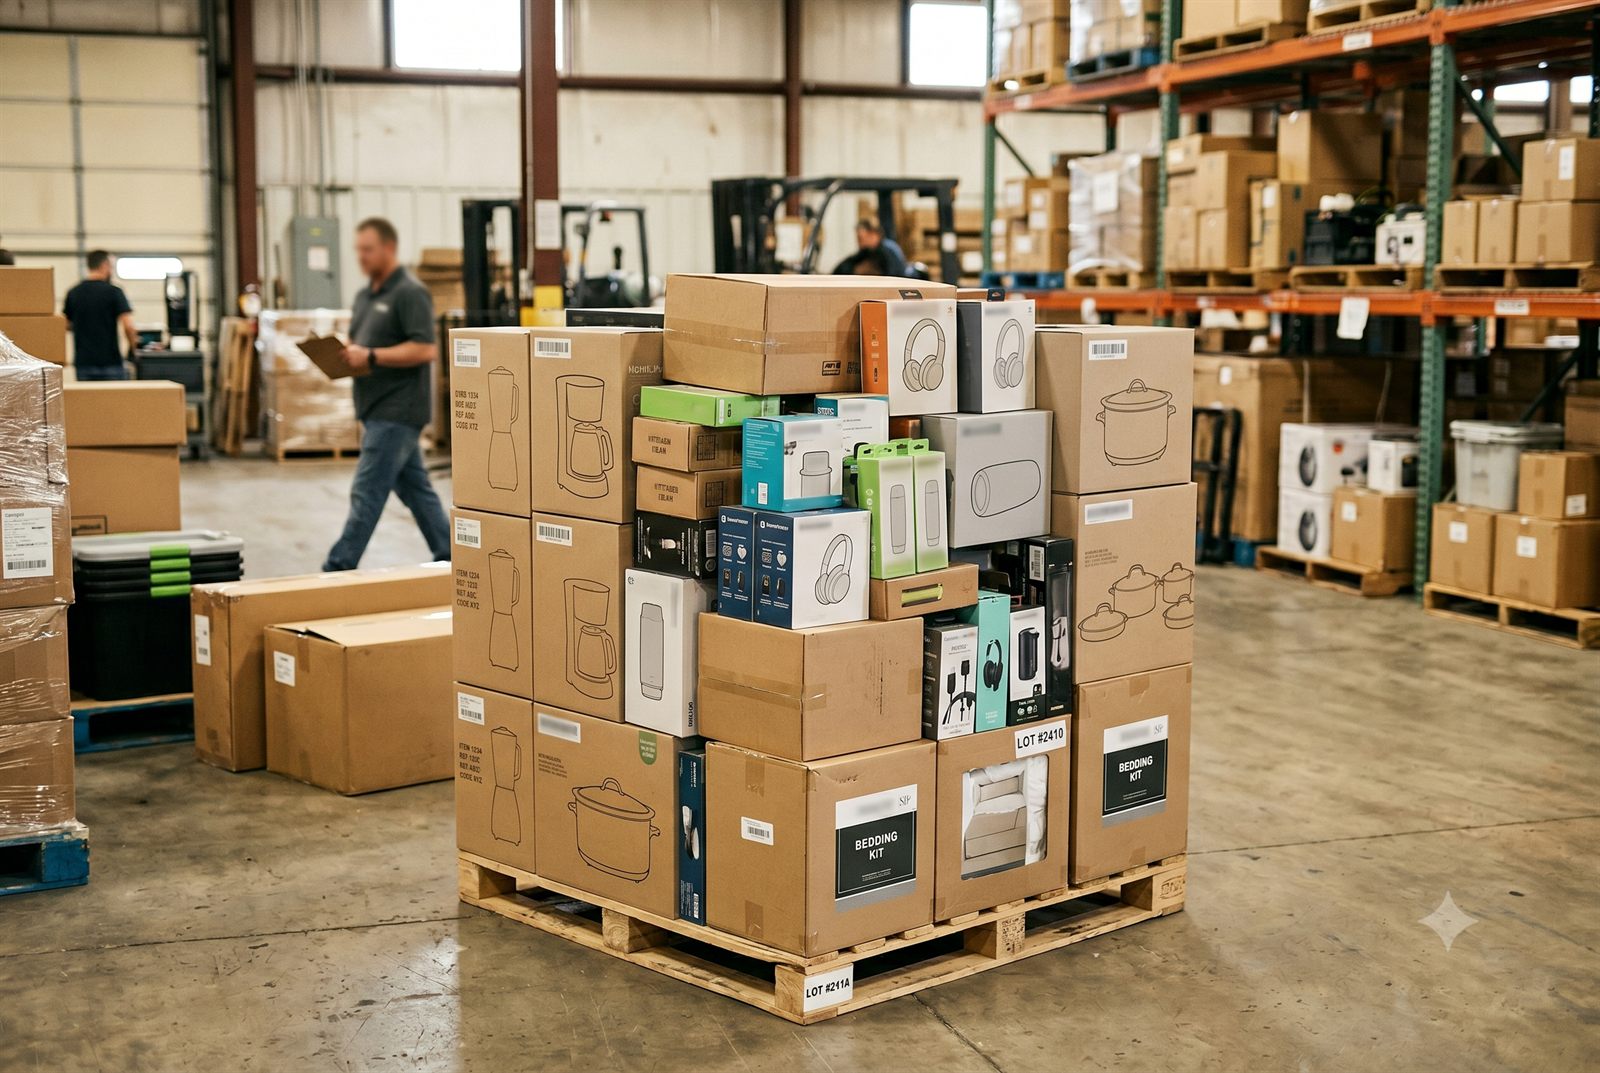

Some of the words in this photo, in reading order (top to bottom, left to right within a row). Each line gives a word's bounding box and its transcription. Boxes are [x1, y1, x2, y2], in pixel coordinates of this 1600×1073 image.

[1017, 734, 1036, 749] LOT
[1038, 727, 1064, 744] #2410
[1118, 755, 1153, 773] BEDDING
[1129, 769, 1142, 782] KIT
[855, 830, 898, 851] BEDDING
[869, 847, 885, 861] KIT
[806, 984, 824, 999] LOT
